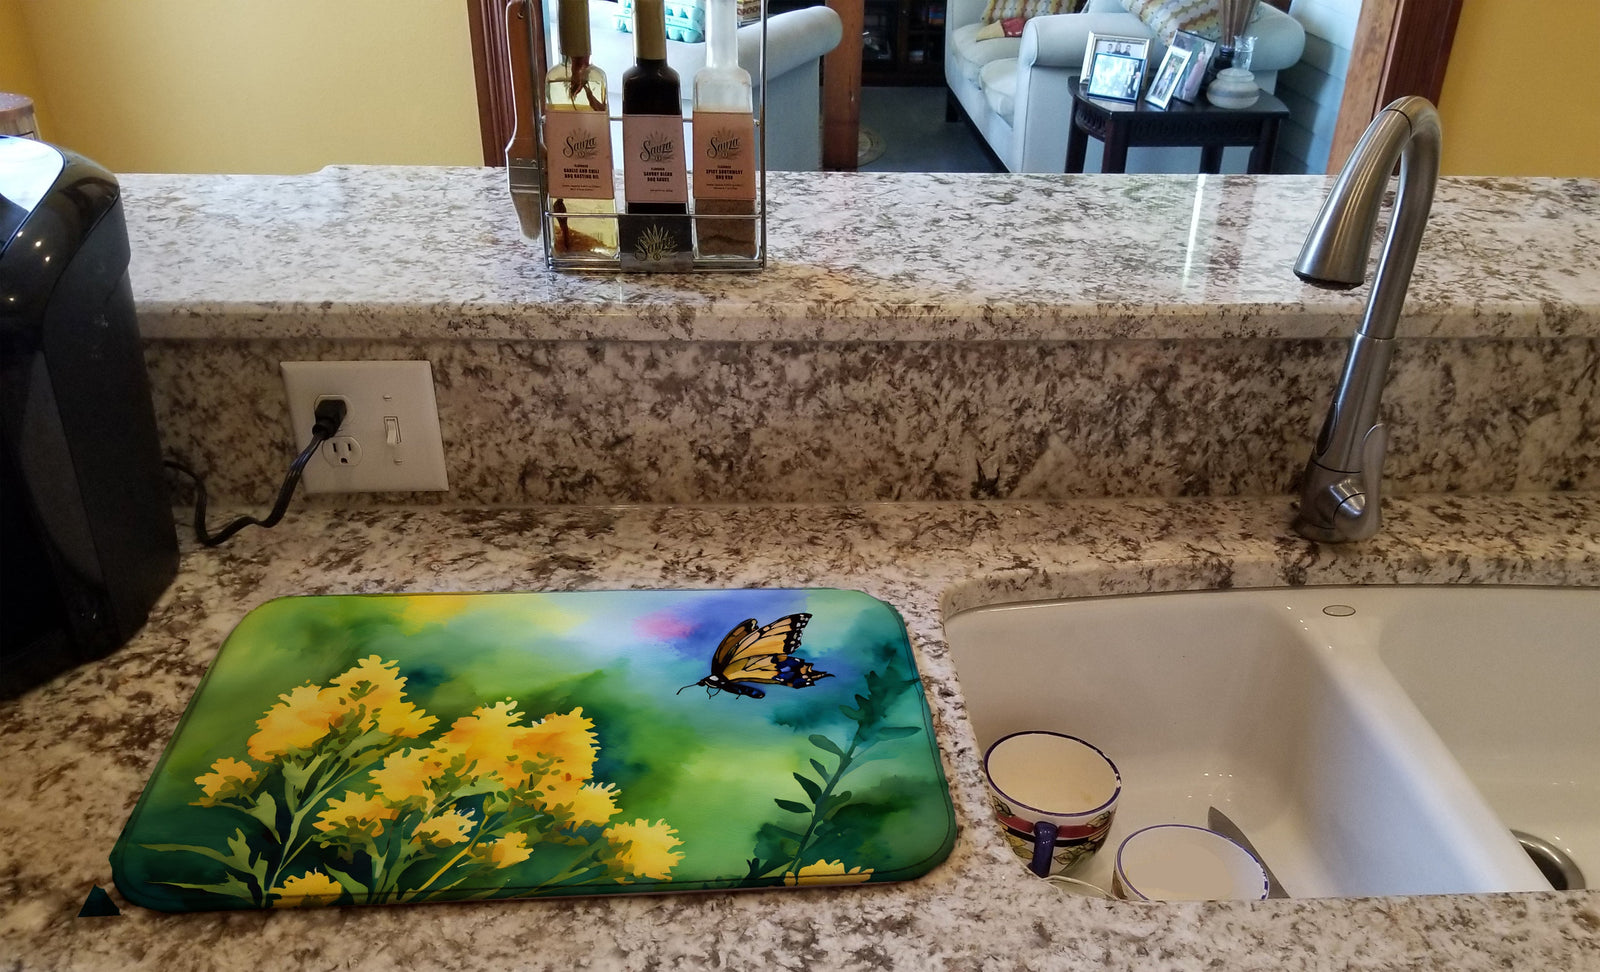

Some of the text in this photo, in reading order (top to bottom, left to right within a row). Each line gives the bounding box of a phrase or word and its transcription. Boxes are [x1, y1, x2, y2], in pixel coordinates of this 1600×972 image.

[562, 136, 597, 158] Sauza
[640, 140, 673, 162] Sauza
[706, 136, 740, 159] Sauza
